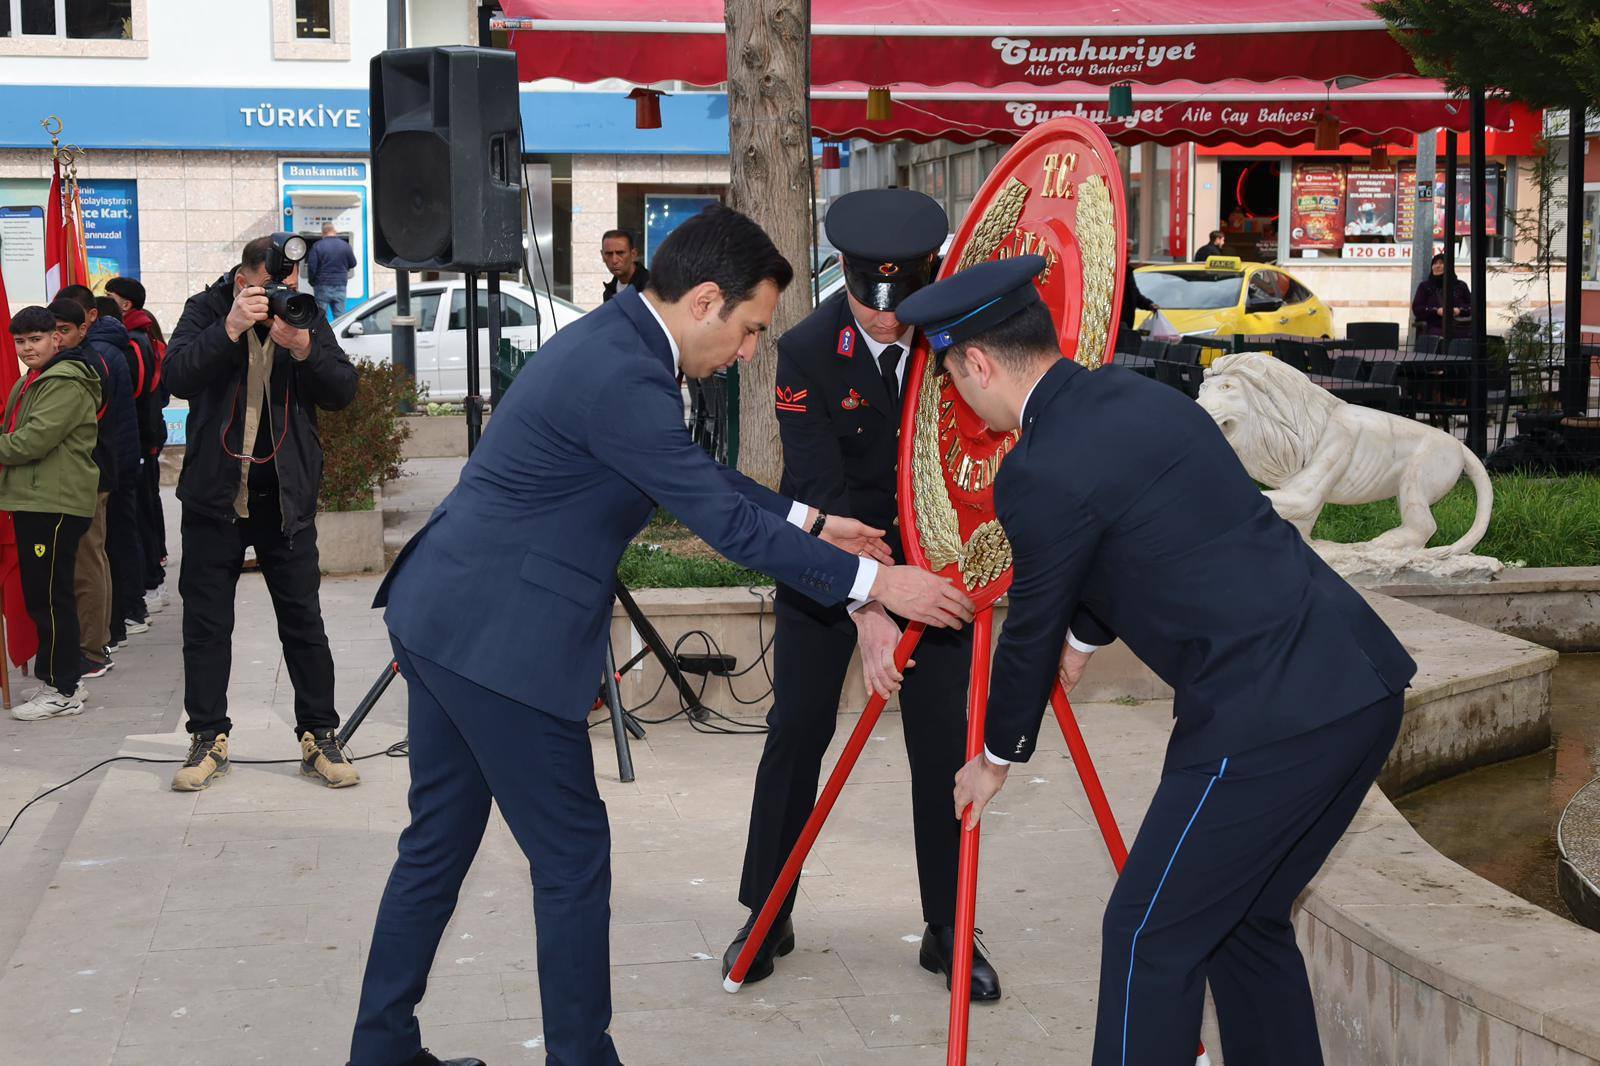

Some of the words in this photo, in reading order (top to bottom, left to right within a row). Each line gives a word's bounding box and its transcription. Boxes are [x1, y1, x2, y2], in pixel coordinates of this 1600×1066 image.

[991, 37, 1196, 67] Cumhuriyet
[1024, 65, 1053, 76] Aile
[1057, 63, 1084, 77] Çay
[1088, 61, 1144, 75] Bahçesi
[240, 103, 361, 128] TÜRKİYE
[1181, 107, 1212, 122] Aile
[1221, 108, 1249, 125] Çay
[1257, 108, 1316, 124] Bahçesi
[290, 166, 359, 177] Bankamatik
[101, 208, 132, 219] Kart,
[1348, 247, 1373, 257] 120
[1378, 247, 1396, 257] GB
